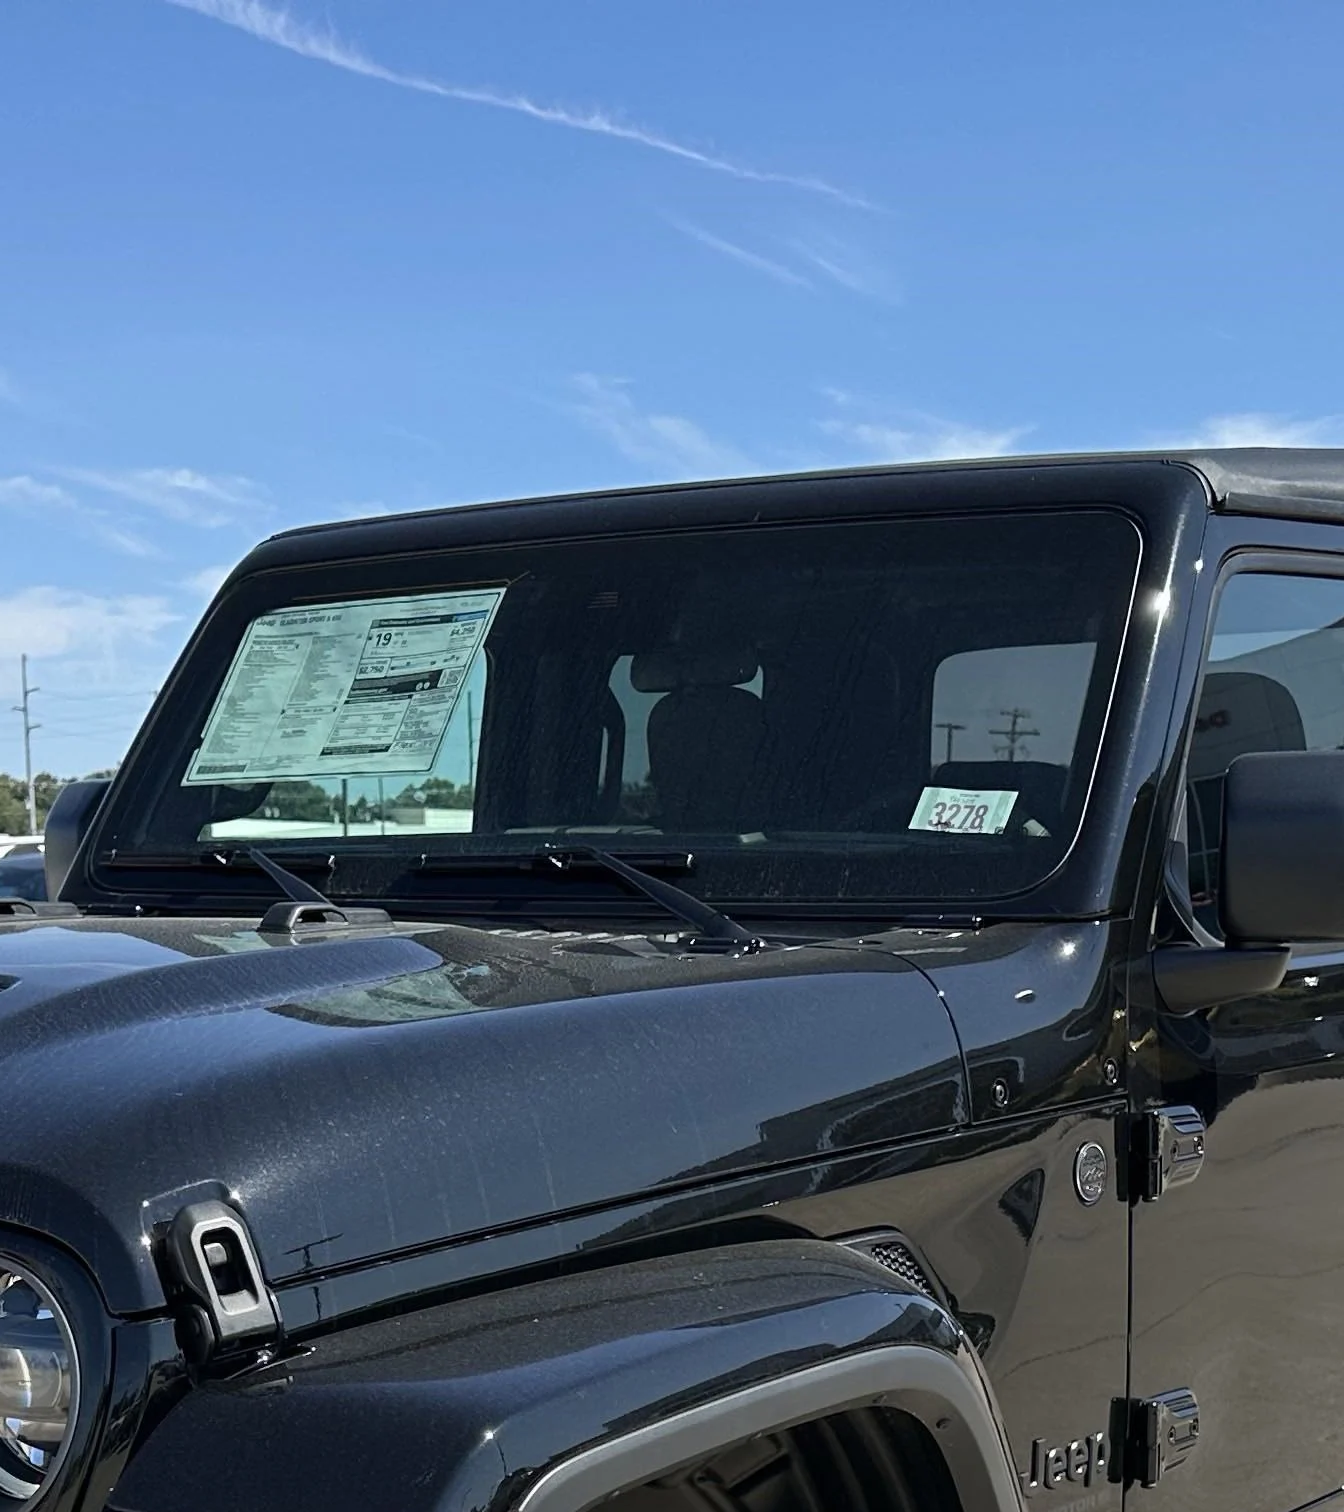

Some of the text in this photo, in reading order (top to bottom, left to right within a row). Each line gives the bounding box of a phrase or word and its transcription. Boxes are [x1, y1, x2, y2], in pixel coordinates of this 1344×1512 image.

[375, 632, 393, 648] 19
[927, 802, 989, 831] 3278
[1017, 1432, 1112, 1498] Jeep
